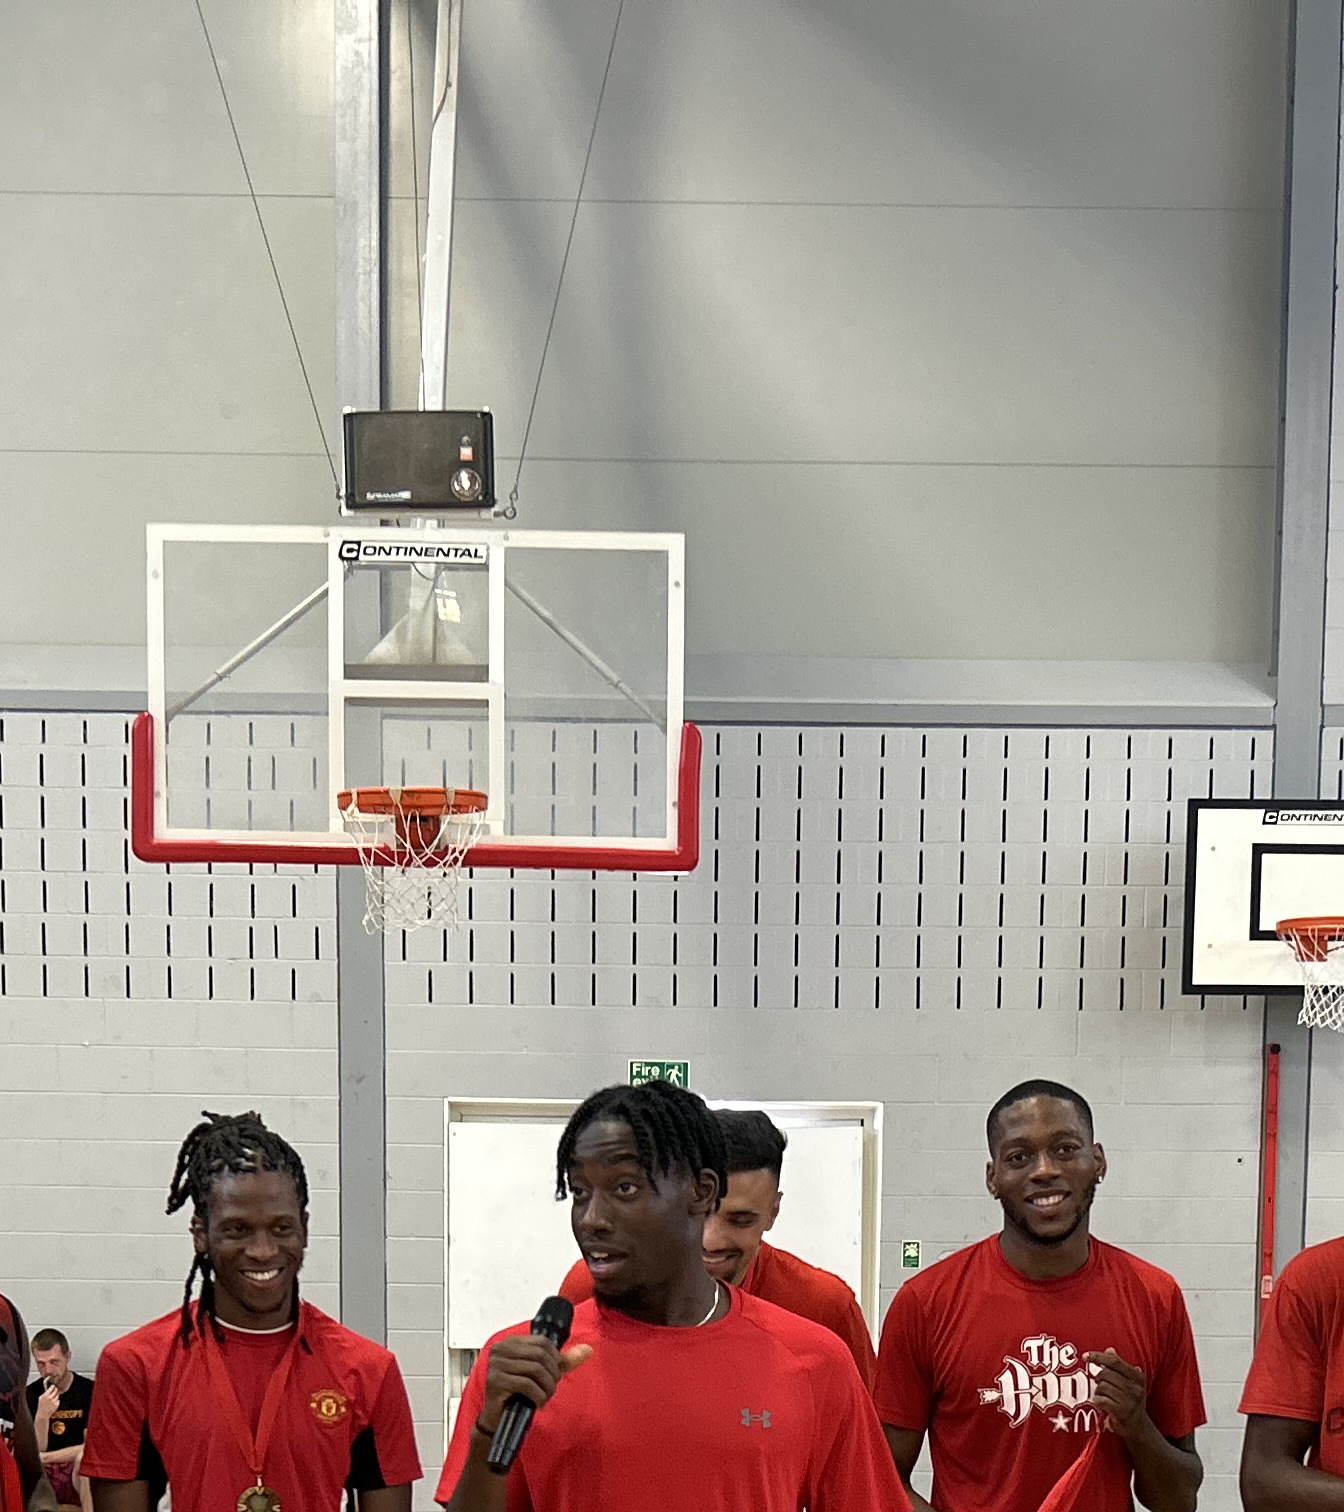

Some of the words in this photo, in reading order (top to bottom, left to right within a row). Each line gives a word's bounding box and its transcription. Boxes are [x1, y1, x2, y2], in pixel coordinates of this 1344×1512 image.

[339, 540, 484, 561] CONTINENTAL
[632, 1063, 660, 1076] Fire
[1022, 1335, 1077, 1373] The
